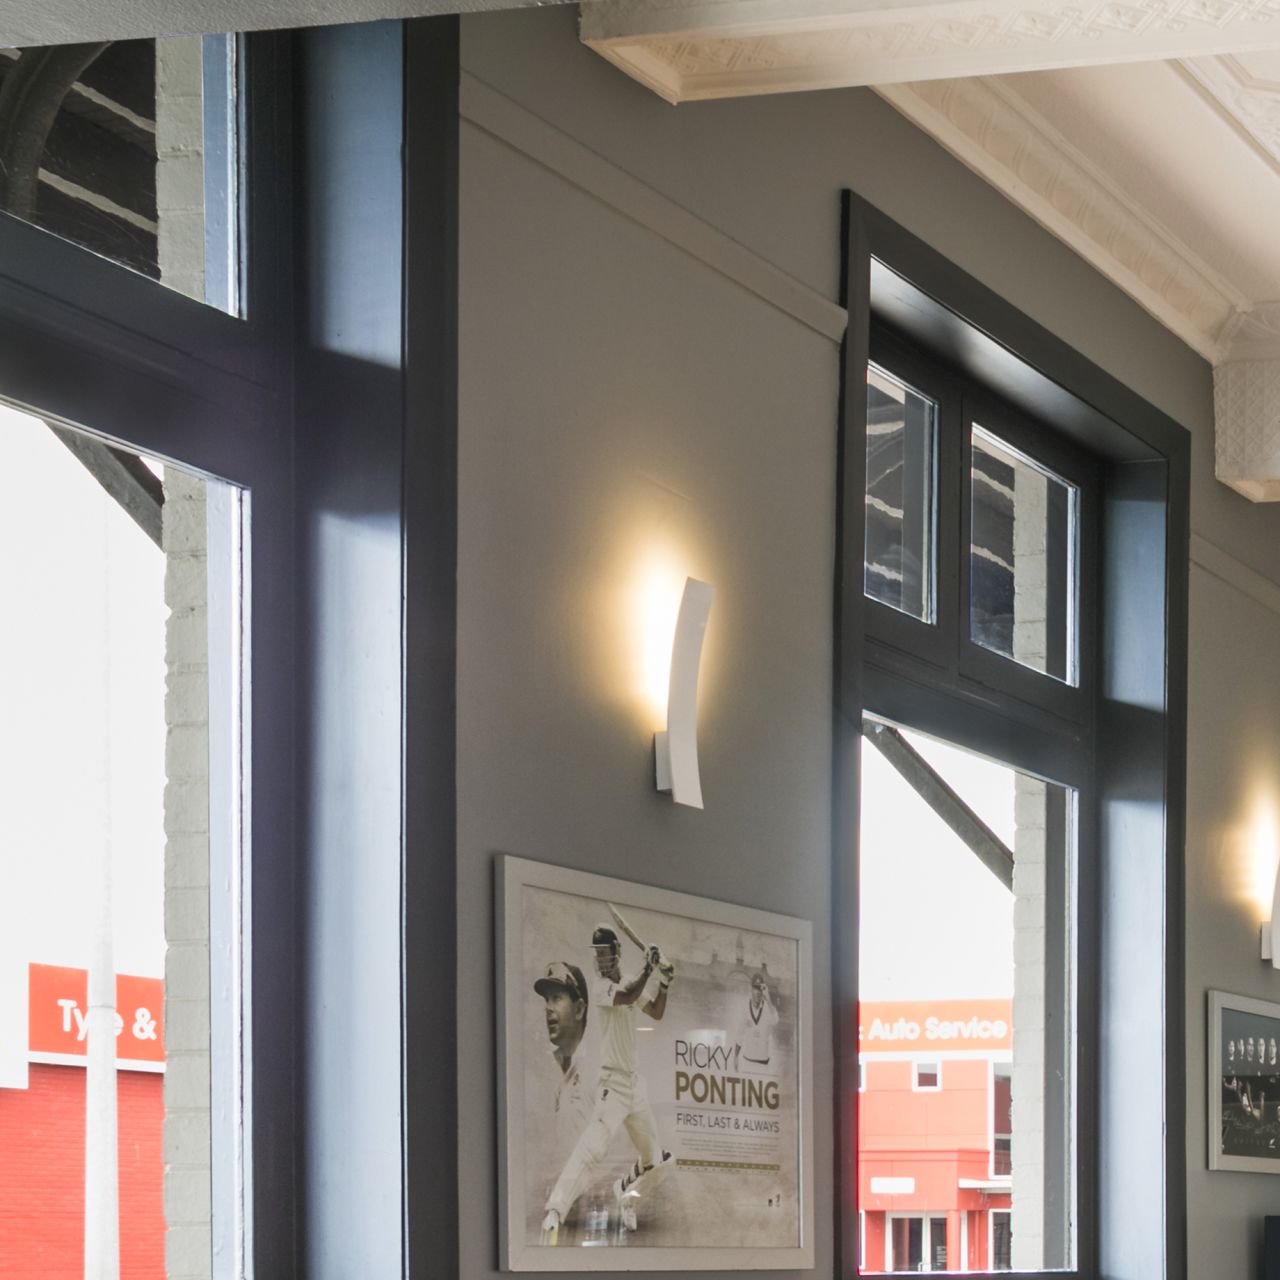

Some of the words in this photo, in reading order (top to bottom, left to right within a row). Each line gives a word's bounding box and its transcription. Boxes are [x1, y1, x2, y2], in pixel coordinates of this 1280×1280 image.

[132, 1007, 157, 1040] &
[868, 1017, 920, 1041] Auto
[925, 1016, 1008, 1041] Service
[675, 1039, 733, 1070] RICKY
[675, 1071, 780, 1110] PONTING
[676, 1112, 704, 1129] FIRST,
[708, 1115, 731, 1131] LAST
[733, 1117, 741, 1131] &
[743, 1118, 780, 1134] ALWAYS
